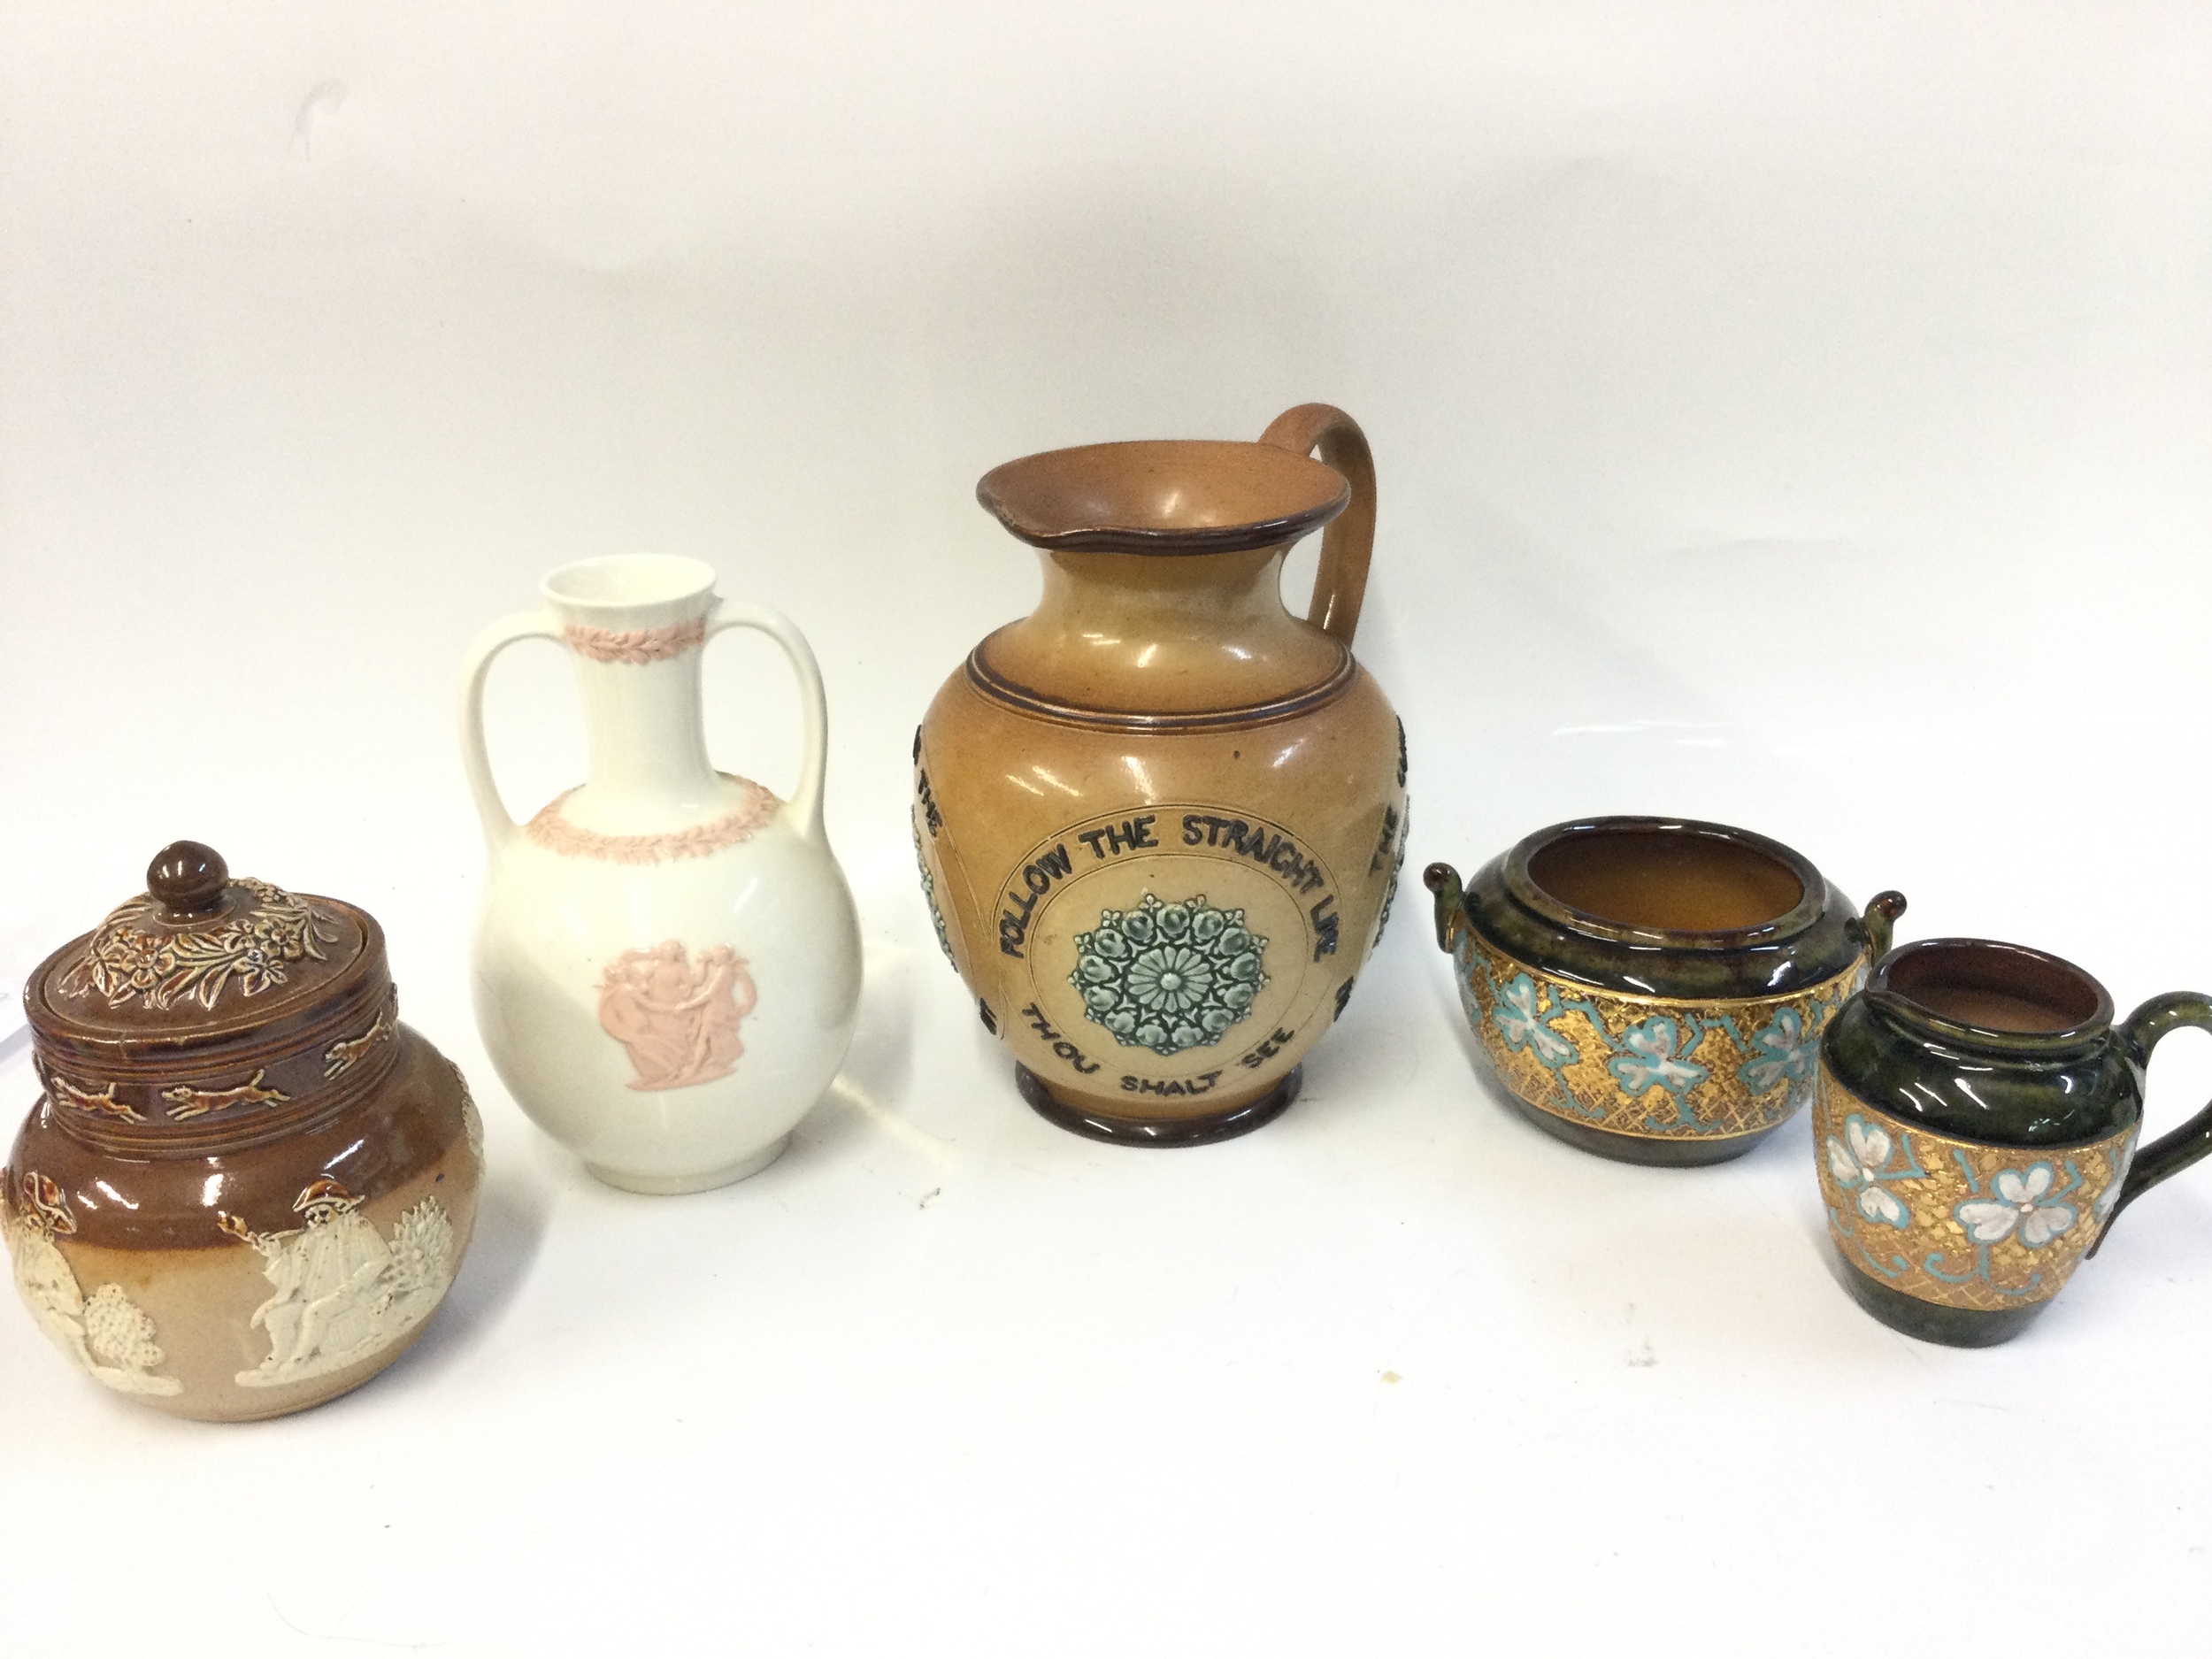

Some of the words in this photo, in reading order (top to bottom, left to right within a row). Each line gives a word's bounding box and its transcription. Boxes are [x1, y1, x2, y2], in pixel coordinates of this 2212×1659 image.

[1000, 844, 1073, 959] FOLLOW
[1079, 816, 1157, 859] THE
[1181, 815, 1325, 894] STRAIGHT
[1021, 1002, 1101, 1075] THOU
[1120, 1072, 1223, 1095] SHALT
[1241, 1027, 1295, 1068] SEE
